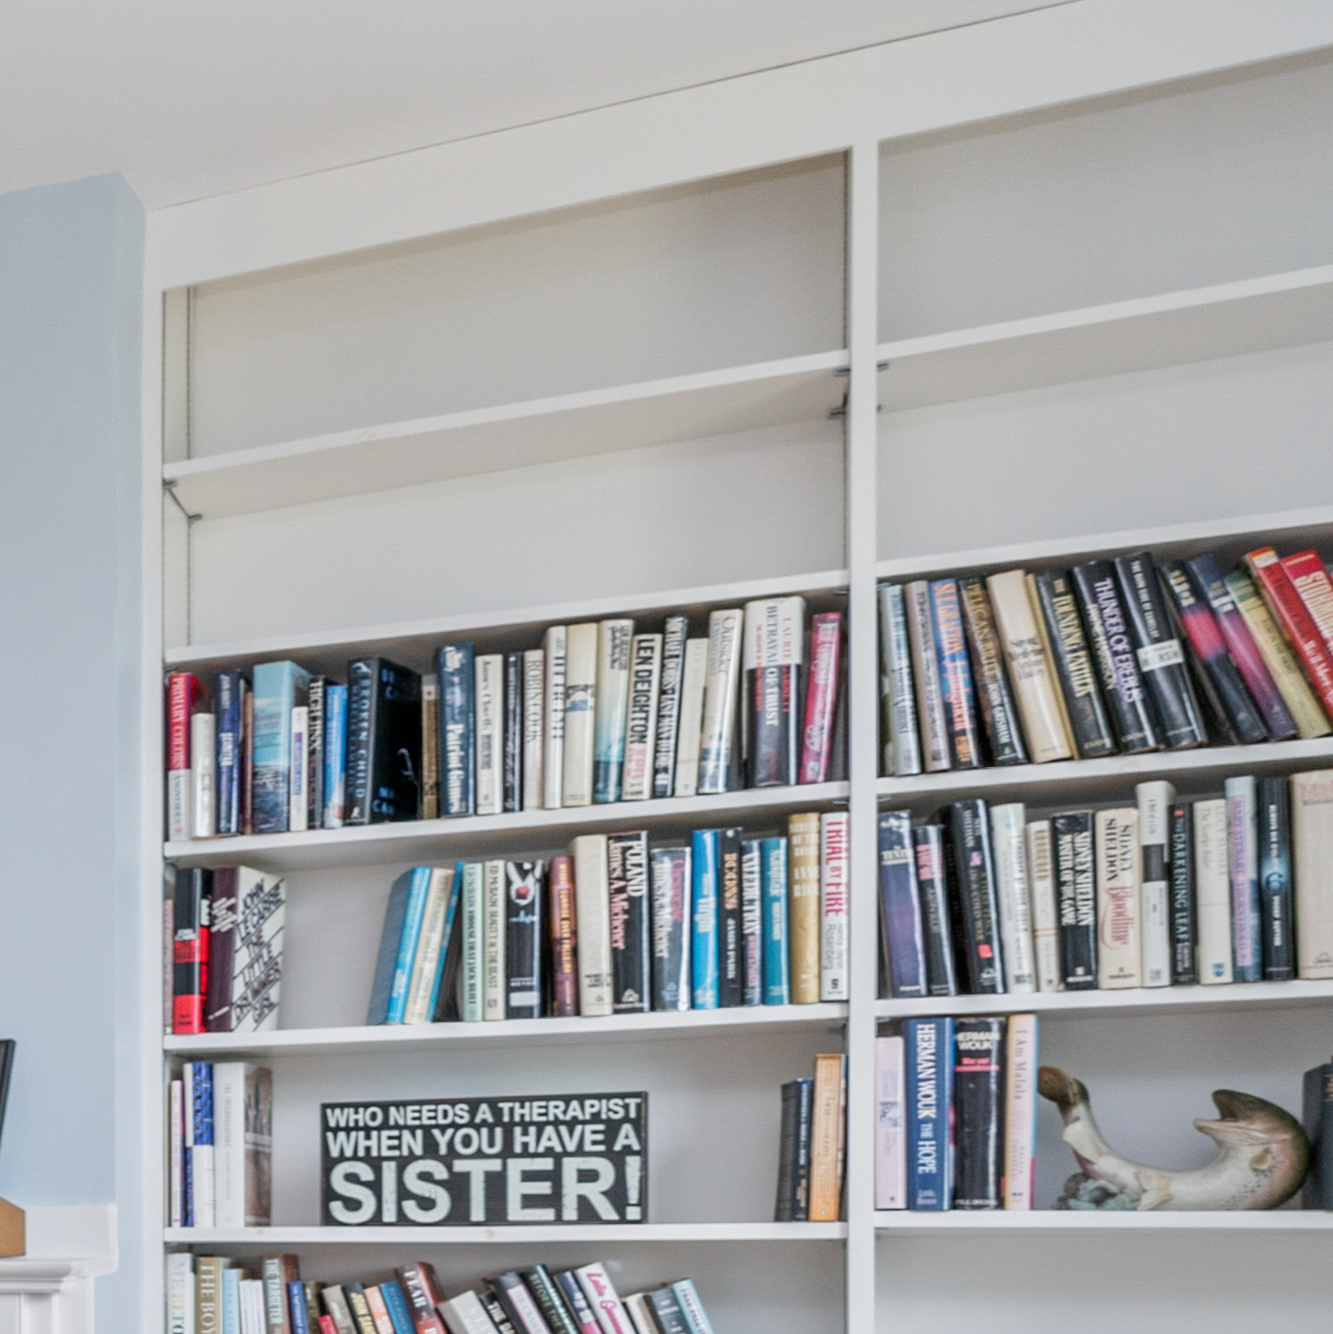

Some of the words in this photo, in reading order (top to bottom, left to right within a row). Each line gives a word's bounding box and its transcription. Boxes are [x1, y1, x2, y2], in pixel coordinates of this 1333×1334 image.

[1093, 578, 1125, 633] THUNDER
[636, 638, 655, 665] LEN
[766, 606, 778, 666] BETRAYAL
[782, 618, 792, 661] LAURIE
[1109, 635, 1131, 652] OF
[525, 660, 542, 700] ROBIN
[766, 668, 776, 685] OF
[1114, 654, 1143, 702] EREBUS
[170, 676, 184, 723] PRIMARY
[358, 679, 370, 741] BROKEN
[629, 670, 653, 744] DEIGHTON
[766, 687, 778, 726] TRUST
[526, 704, 543, 744] COOK
[172, 725, 185, 770] COLORS
[446, 724, 464, 768] Patriot
[356, 750, 366, 798] CHILD
[450, 770, 465, 813] Games
[608, 840, 627, 878] James
[825, 819, 849, 865] TRIAL
[1074, 831, 1092, 871] SIDNEY
[1104, 818, 1118, 882] SHELDON
[1119, 825, 1133, 872] SIDNEY
[610, 880, 627, 892] A.
[624, 840, 646, 897] POLAND
[653, 858, 671, 895] James
[724, 853, 737, 910] ICONS
[830, 866, 842, 879] BY
[1173, 833, 1187, 909] DARKENING
[742, 852, 761, 934] VALEDICTION
[824, 882, 849, 918] FIRE
[1076, 873, 1094, 925] SHELDON
[610, 893, 629, 950] Michener
[654, 908, 672, 958] Michener
[1105, 886, 1134, 945] Bloodline
[1174, 912, 1187, 940] LEAF
[916, 1024, 936, 1079] HERMAN
[1015, 1039, 1028, 1057] Am
[917, 1080, 937, 1119] WOUK
[1013, 1061, 1026, 1100] Malala
[326, 1107, 383, 1128] WHO
[388, 1103, 471, 1126] NEEDS
[474, 1103, 495, 1124] A
[498, 1098, 642, 1122] THERAPIST
[920, 1123, 933, 1139] THE
[326, 1129, 424, 1158] WHEN
[431, 1126, 503, 1156] YOU
[513, 1124, 606, 1153] HAVE
[613, 1123, 641, 1151] A
[917, 1140, 937, 1174] HOPE
[328, 1155, 642, 1224] SISTER!
[201, 1264, 215, 1298] THE
[265, 1258, 279, 1276] THE
[266, 1278, 282, 1324] TARGETER
[349, 1290, 368, 1317] JOHN
[403, 1268, 427, 1309] FEAR
[486, 1300, 506, 1323] THE
